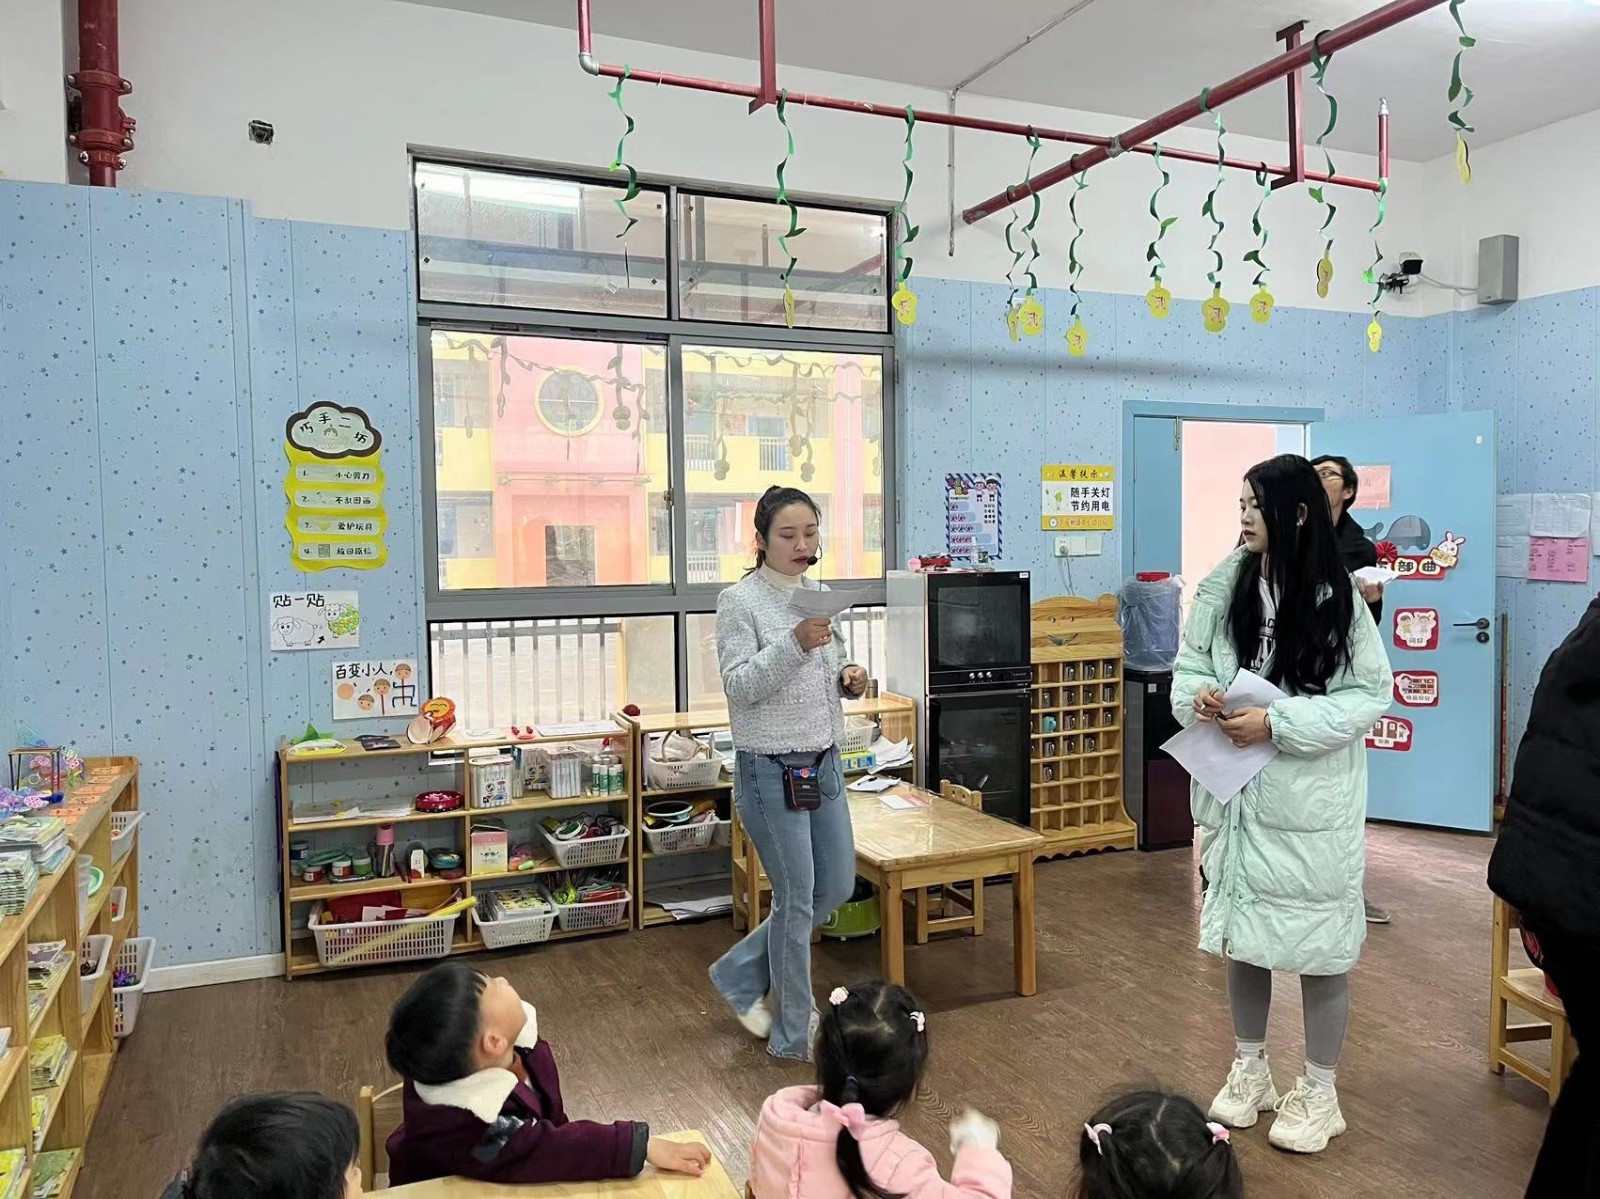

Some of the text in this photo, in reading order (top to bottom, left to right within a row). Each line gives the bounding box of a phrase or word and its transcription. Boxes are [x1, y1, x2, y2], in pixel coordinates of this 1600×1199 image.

[335, 472, 370, 480] 小心剪刀
[1059, 469, 1098, 479] 温馨提示
[1070, 487, 1110, 498] 随手关灯
[1070, 501, 1110, 512] 节约用电
[337, 522, 373, 531] 爱护玩具
[336, 547, 372, 555] 放回原位
[273, 593, 325, 608] 贴一贴
[335, 662, 388, 680] 百变小人
